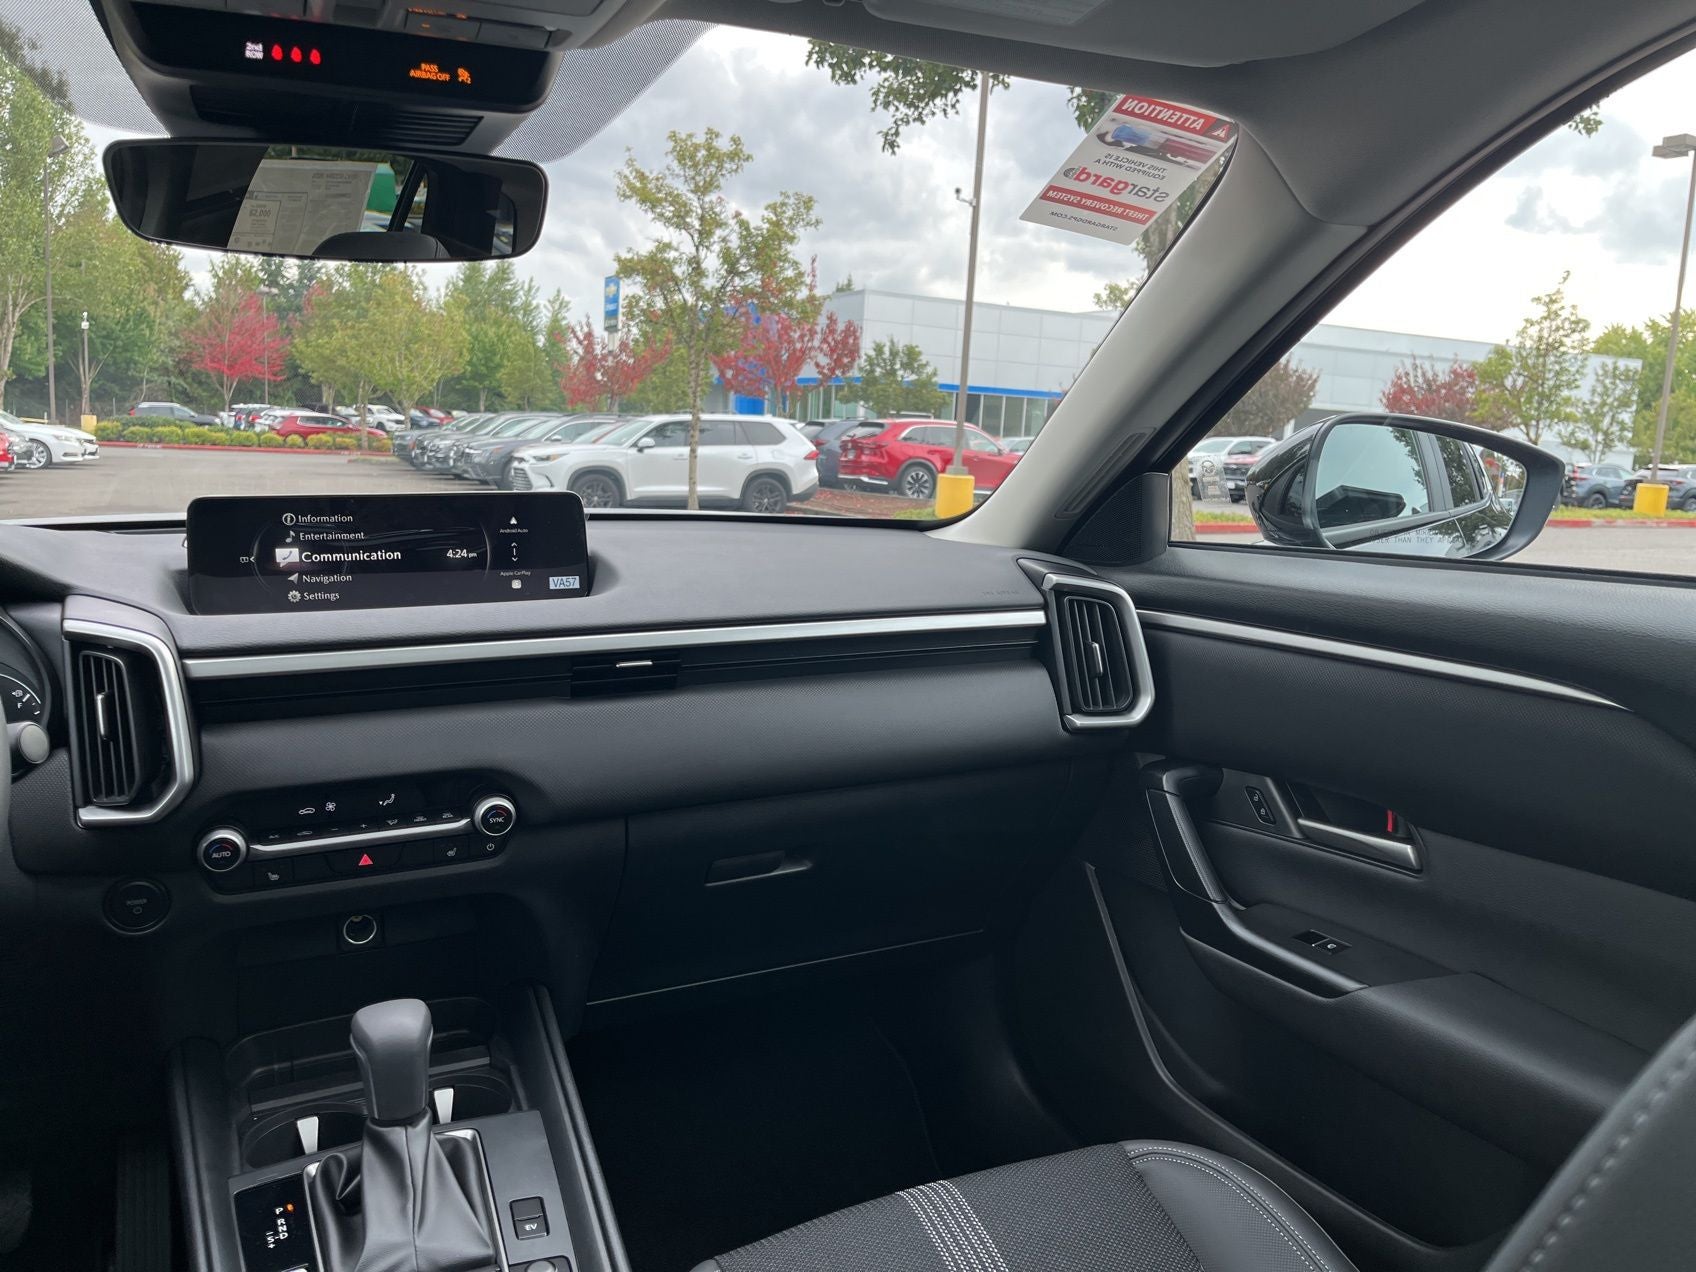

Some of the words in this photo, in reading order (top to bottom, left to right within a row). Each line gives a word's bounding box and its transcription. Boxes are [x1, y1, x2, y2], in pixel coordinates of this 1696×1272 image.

[246, 42, 263, 52] 2nd
[245, 50, 264, 60] ROW
[421, 63, 438, 72] PASS
[437, 73, 450, 81] OFF
[298, 514, 353, 523] Information
[300, 532, 364, 540] Entertainment
[1394, 536, 1412, 544] THAN
[1416, 536, 1433, 544] THEY
[301, 550, 402, 562] Communication
[447, 549, 467, 558] 4:24
[302, 574, 352, 585] Navigation
[552, 577, 577, 587] VA57
[304, 591, 340, 602] Settings
[489, 816, 505, 824] SYNC
[275, 1207, 283, 1215] P
[277, 1218, 286, 1226] R
[278, 1224, 287, 1233] N
[524, 1223, 537, 1231] EV
